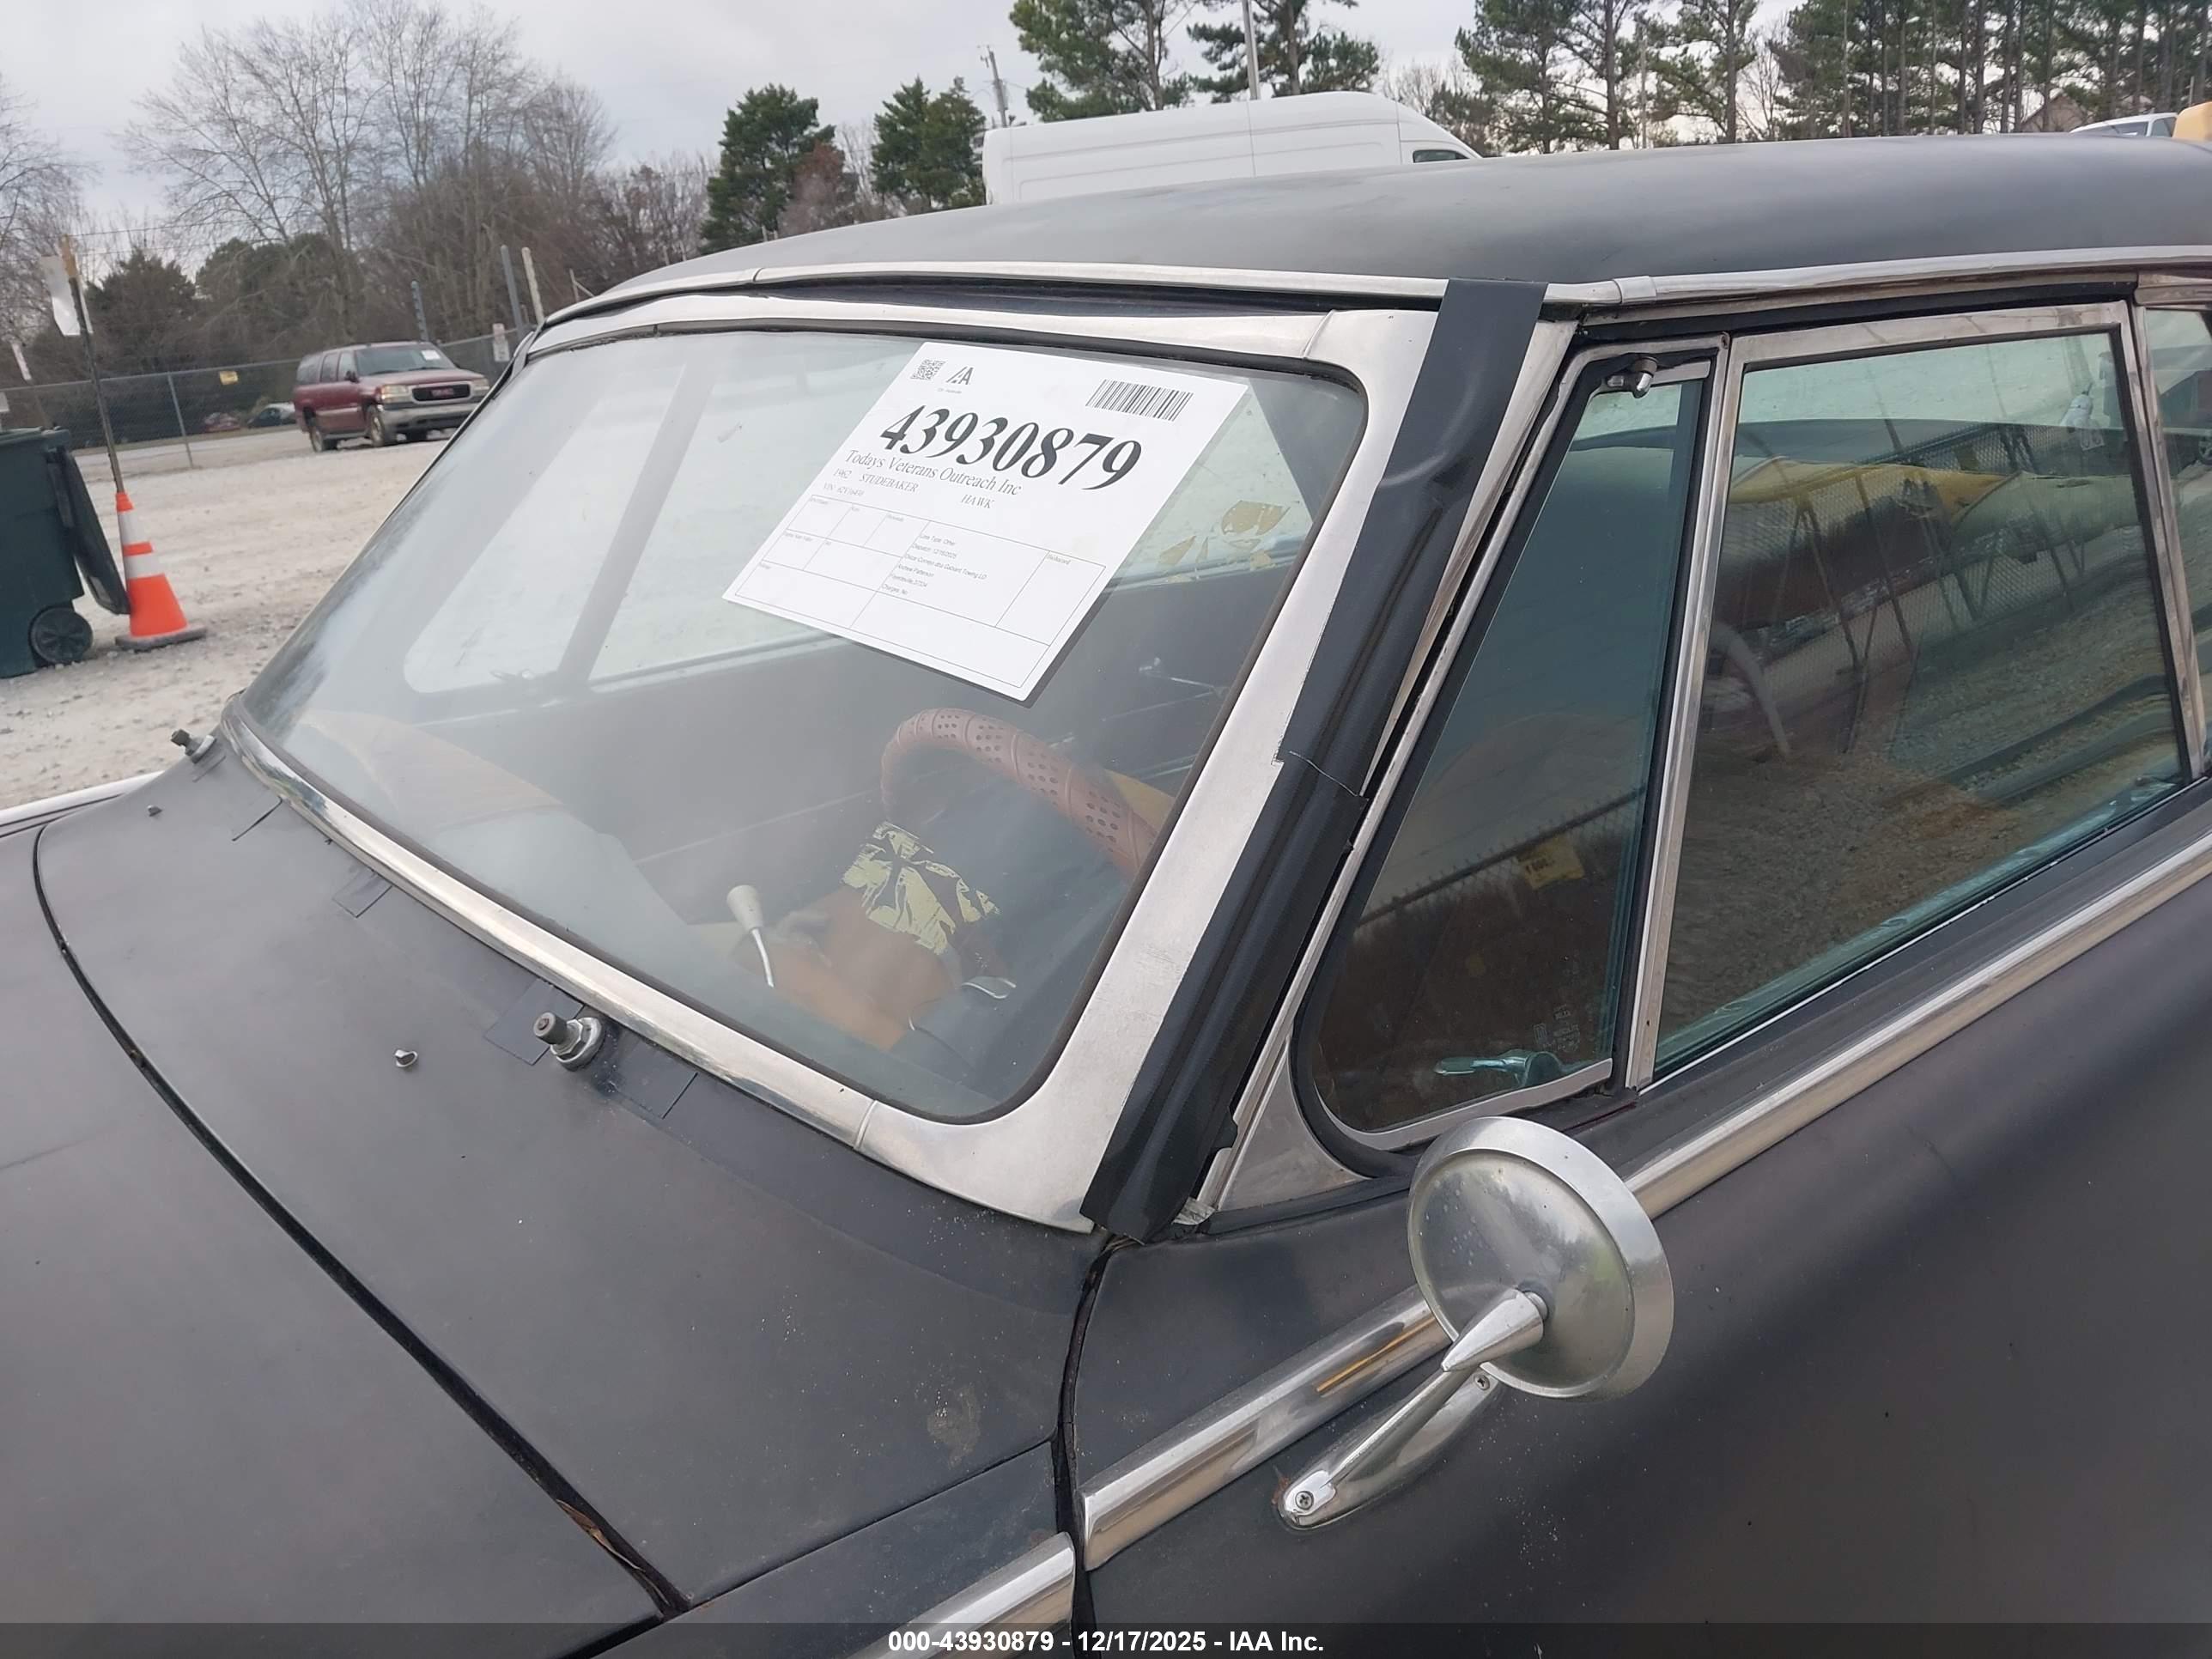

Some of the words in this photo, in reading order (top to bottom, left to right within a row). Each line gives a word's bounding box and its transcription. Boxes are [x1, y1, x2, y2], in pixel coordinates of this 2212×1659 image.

[879, 404, 1142, 490] 43930879
[845, 449, 886, 470] Todays
[889, 457, 937, 478] Veterans
[939, 466, 996, 492] Outreach
[998, 476, 1022, 496] Inc
[859, 473, 919, 493] STUDEBAKER
[960, 493, 995, 509] HAWK
